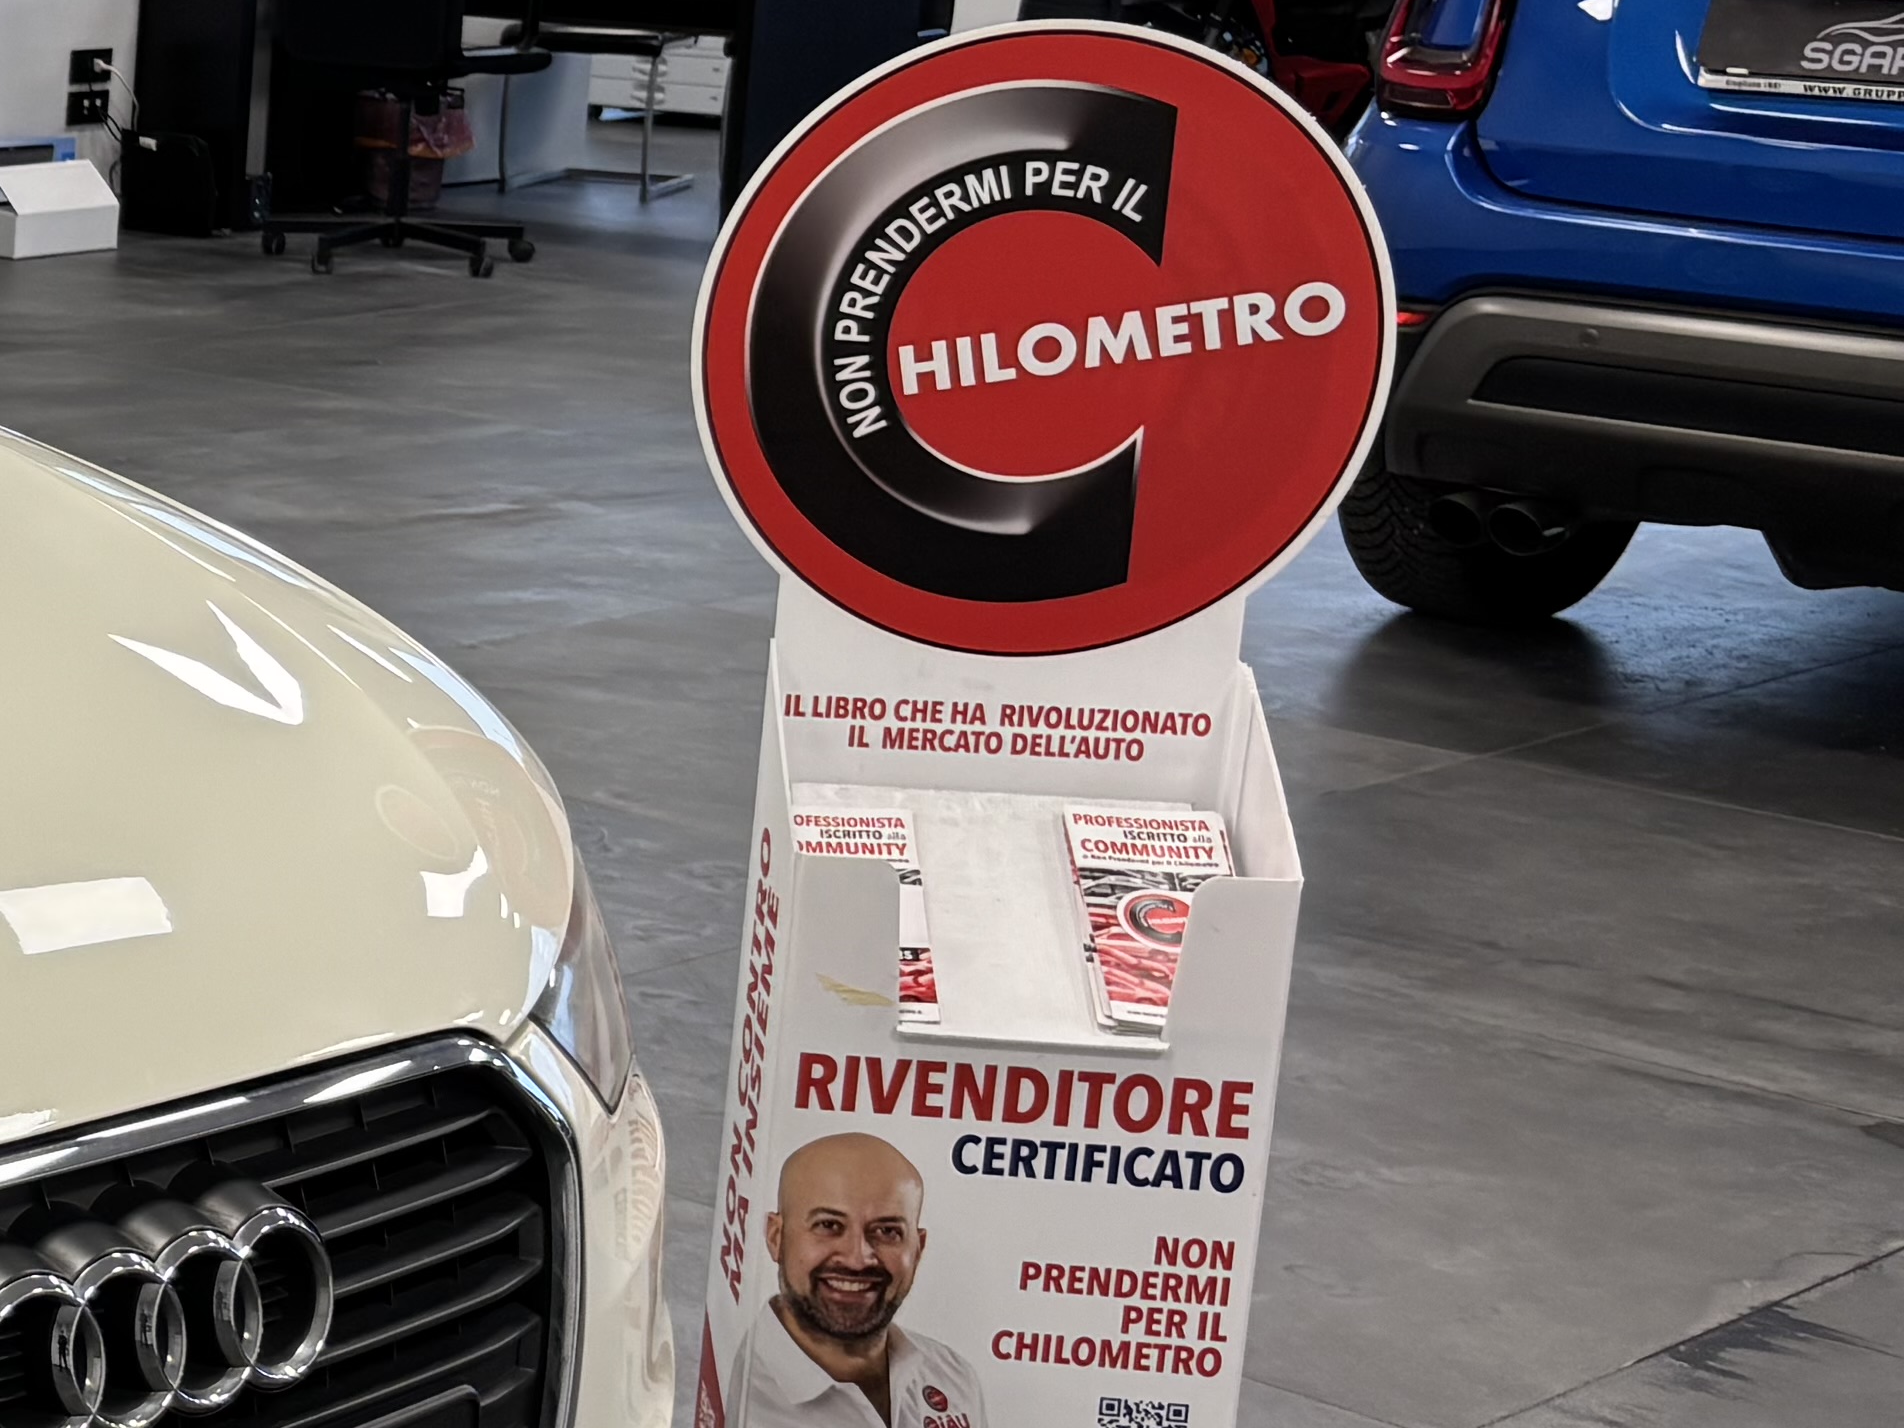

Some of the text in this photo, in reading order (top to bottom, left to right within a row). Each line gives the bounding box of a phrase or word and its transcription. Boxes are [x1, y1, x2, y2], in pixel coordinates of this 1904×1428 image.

[834, 161, 1148, 438] NON PRENDERMI PER IL
[784, 694, 1212, 737] IL LIBRO CHE HA RIVOLUZIONATO
[848, 725, 1145, 762] IL MERCATO DELL'AUTO
[793, 814, 906, 829] OFESSIONISTA
[820, 829, 907, 841] ISCRITTO alla
[1072, 813, 1211, 832] PROFESSIONISTA
[1123, 829, 1213, 843] ISCRITTO alla
[796, 840, 907, 857] MMUNITY
[1080, 838, 1214, 860] COMMUNITY
[720, 827, 771, 1280] NON CONTRO
[729, 885, 780, 1306] MA INSIEME
[794, 1051, 1254, 1141] RIVENDITORE
[951, 1133, 1245, 1194] CERTIFICATO
[1153, 1235, 1236, 1271] NON
[1019, 1261, 1231, 1307] PRENDERMI
[1120, 1306, 1228, 1343] PER IL
[991, 1329, 1223, 1378] CHILOMETRO
